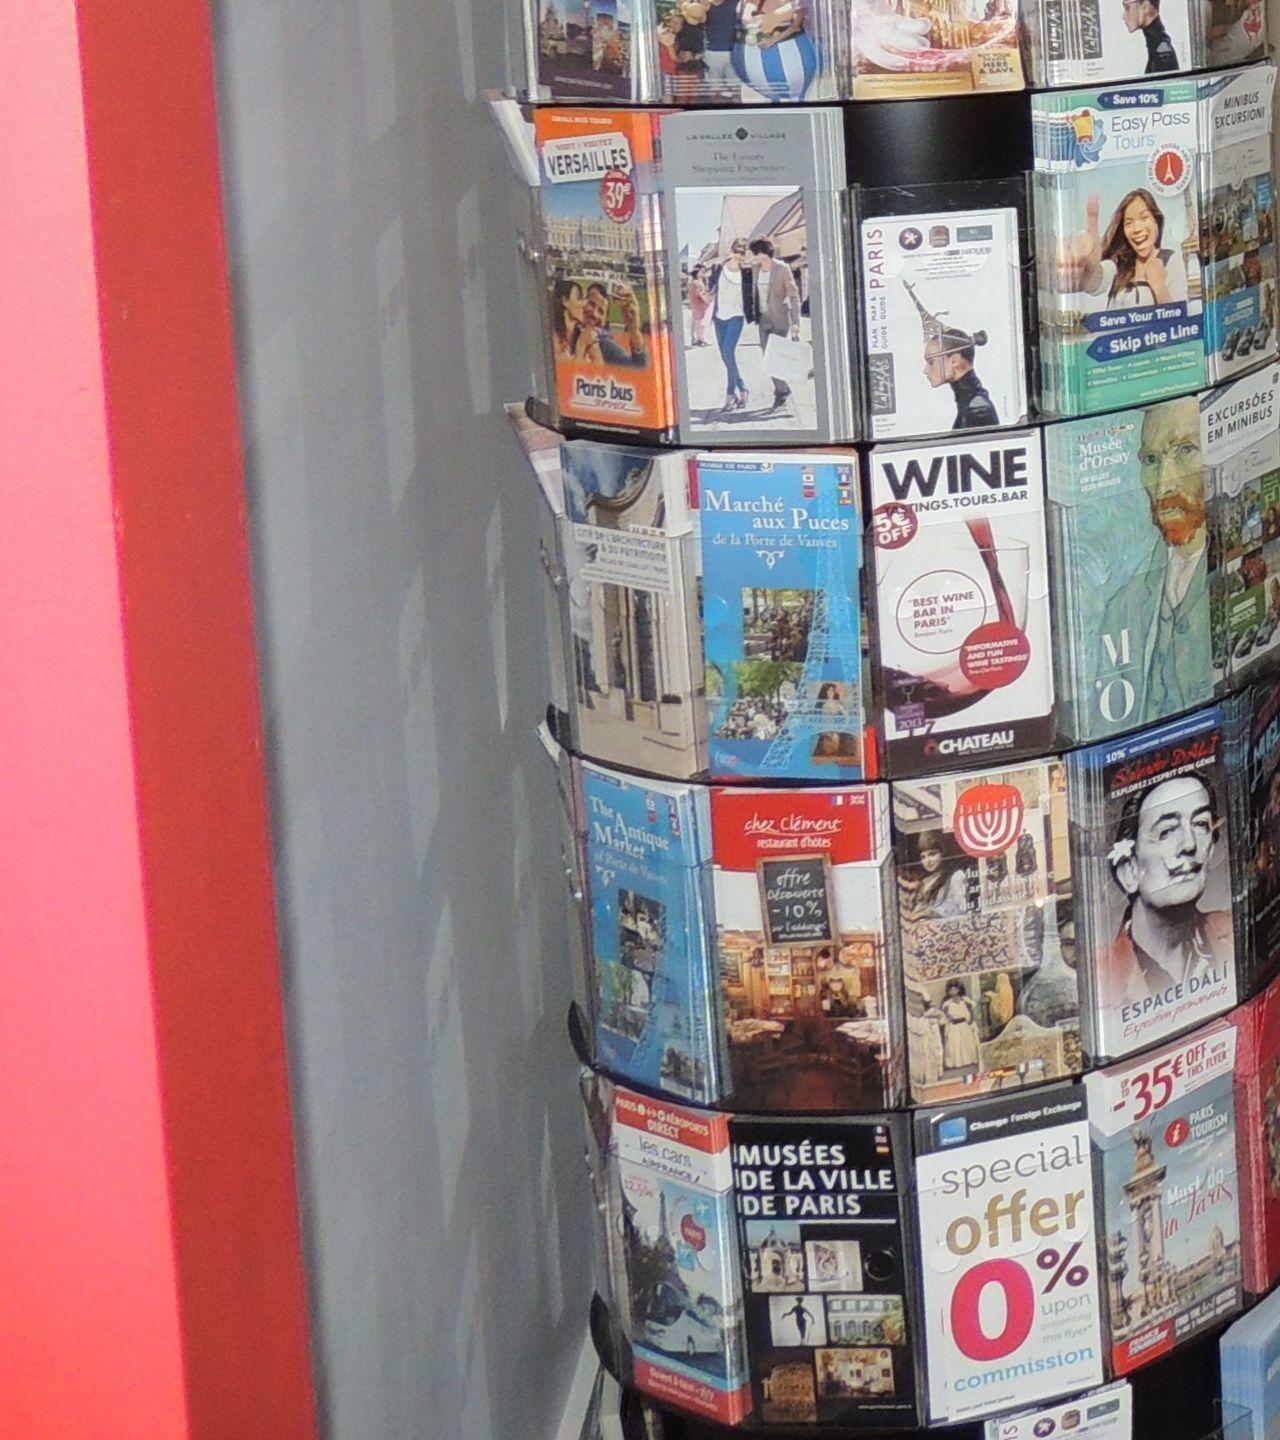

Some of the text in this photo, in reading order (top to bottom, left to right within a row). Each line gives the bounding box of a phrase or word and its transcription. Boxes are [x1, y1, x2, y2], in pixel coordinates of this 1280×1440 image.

[1113, 94, 1136, 105] Save
[1138, 93, 1159, 104] 10%
[1223, 92, 1259, 108] MINIBUS
[1112, 112, 1190, 133] Easy Pass
[1215, 107, 1266, 129] EXCURSIONI
[1113, 135, 1155, 150] Tours
[547, 148, 628, 176] VERSAILLES
[866, 228, 885, 289] PARIS
[1100, 308, 1182, 327] Save Your Time
[879, 326, 887, 349] GUIDE
[1110, 324, 1199, 353] Skip the Line
[576, 378, 633, 402] Paris bus
[1208, 405, 1272, 443] EM MINIBUS
[1079, 437, 1122, 457] Musée
[1080, 451, 1130, 471] d'Orsay
[881, 447, 1028, 501] WINE
[705, 490, 785, 513] Marché
[752, 508, 849, 531] aux Puces
[874, 508, 910, 532] 5€
[713, 532, 838, 547] de la Porte de Vanves
[879, 523, 914, 545] OFF
[942, 591, 975, 602] WINE
[913, 605, 954, 618] BAR IN
[968, 650, 985, 659] AND
[939, 730, 1014, 754] CHATEAU
[589, 795, 614, 818] The
[615, 812, 670, 852] Antique
[744, 811, 843, 831] chez Clément
[593, 821, 645, 860] Market
[777, 867, 811, 888] offre
[1121, 983, 1183, 1023] ESPACE
[1186, 1042, 1207, 1066] OFF
[1187, 1063, 1203, 1078] THIS
[970, 1101, 1082, 1131] Change Foreign Exchange
[1190, 1103, 1215, 1124] PARIS
[1191, 1112, 1229, 1139] TOURISM
[639, 1135, 692, 1168] les cars
[739, 1140, 845, 1166] MUSÉES
[941, 1135, 1084, 1199] special
[740, 1168, 894, 1191] DE LA VILLE
[742, 1194, 862, 1216] DE PARIS
[945, 1188, 1085, 1257] offer
[1041, 1293, 1092, 1316] upon
[1042, 1331, 1062, 1343] this
[954, 1347, 1094, 1392] commission
